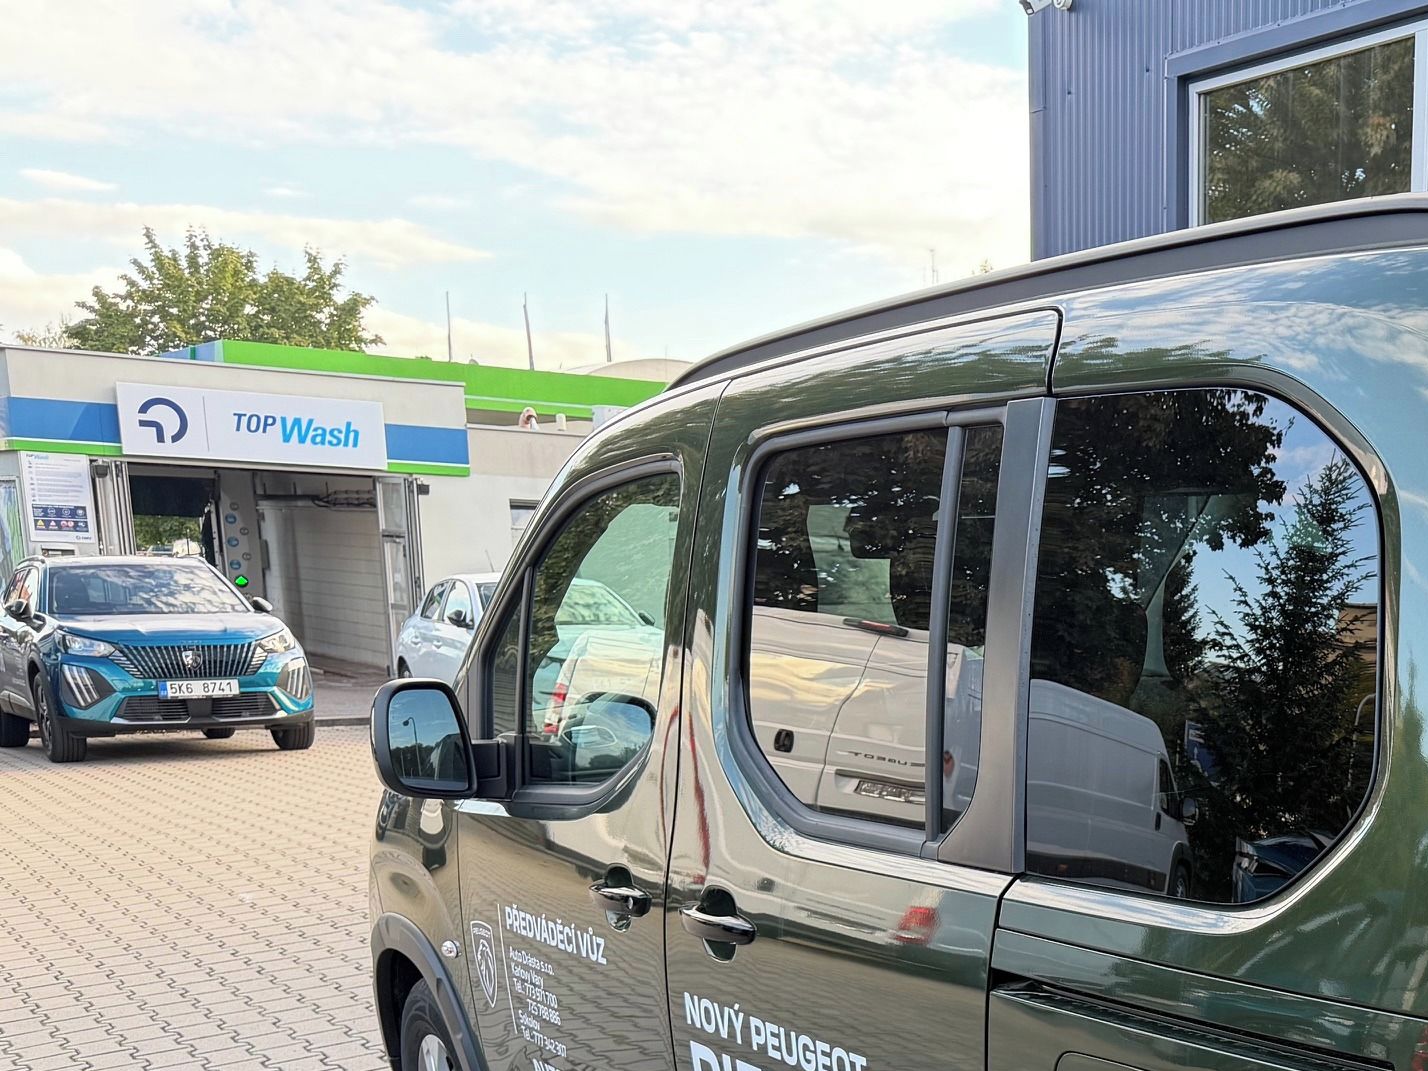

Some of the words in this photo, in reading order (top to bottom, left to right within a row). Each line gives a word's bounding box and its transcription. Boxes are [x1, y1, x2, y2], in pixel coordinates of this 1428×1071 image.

[233, 412, 277, 434] TOP
[280, 415, 360, 448] Wash
[170, 682, 193, 695] 5K6
[202, 682, 232, 693] 8741
[505, 903, 577, 954] PŘEDVÁDĚCÍ
[577, 927, 607, 965] VŮZ
[683, 991, 744, 1045] NOVÝ
